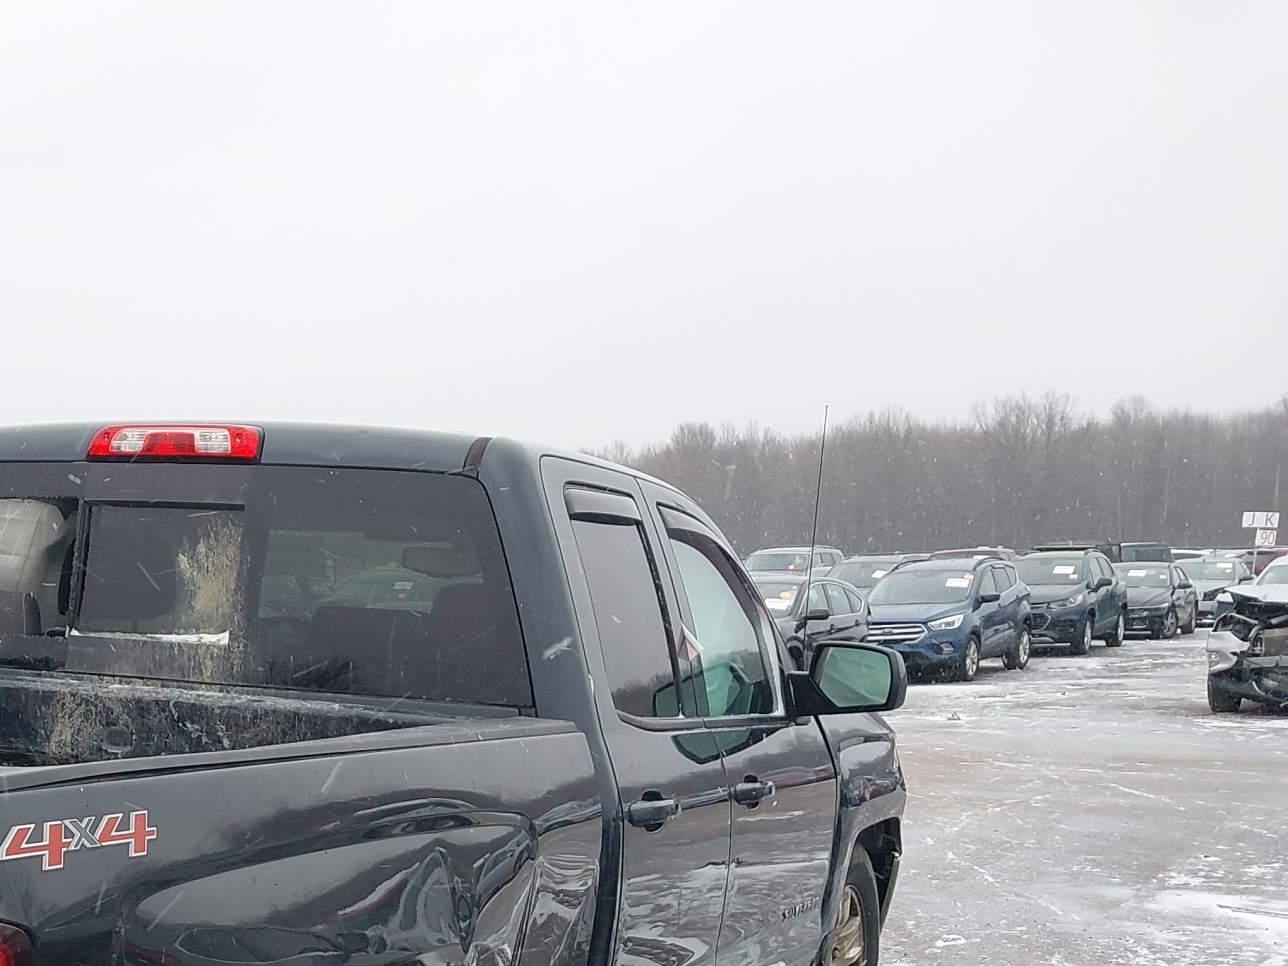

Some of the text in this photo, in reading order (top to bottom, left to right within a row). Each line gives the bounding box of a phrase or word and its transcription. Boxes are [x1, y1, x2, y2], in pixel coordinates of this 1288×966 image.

[1247, 512, 1275, 526] J K
[1261, 531, 1275, 545] 90
